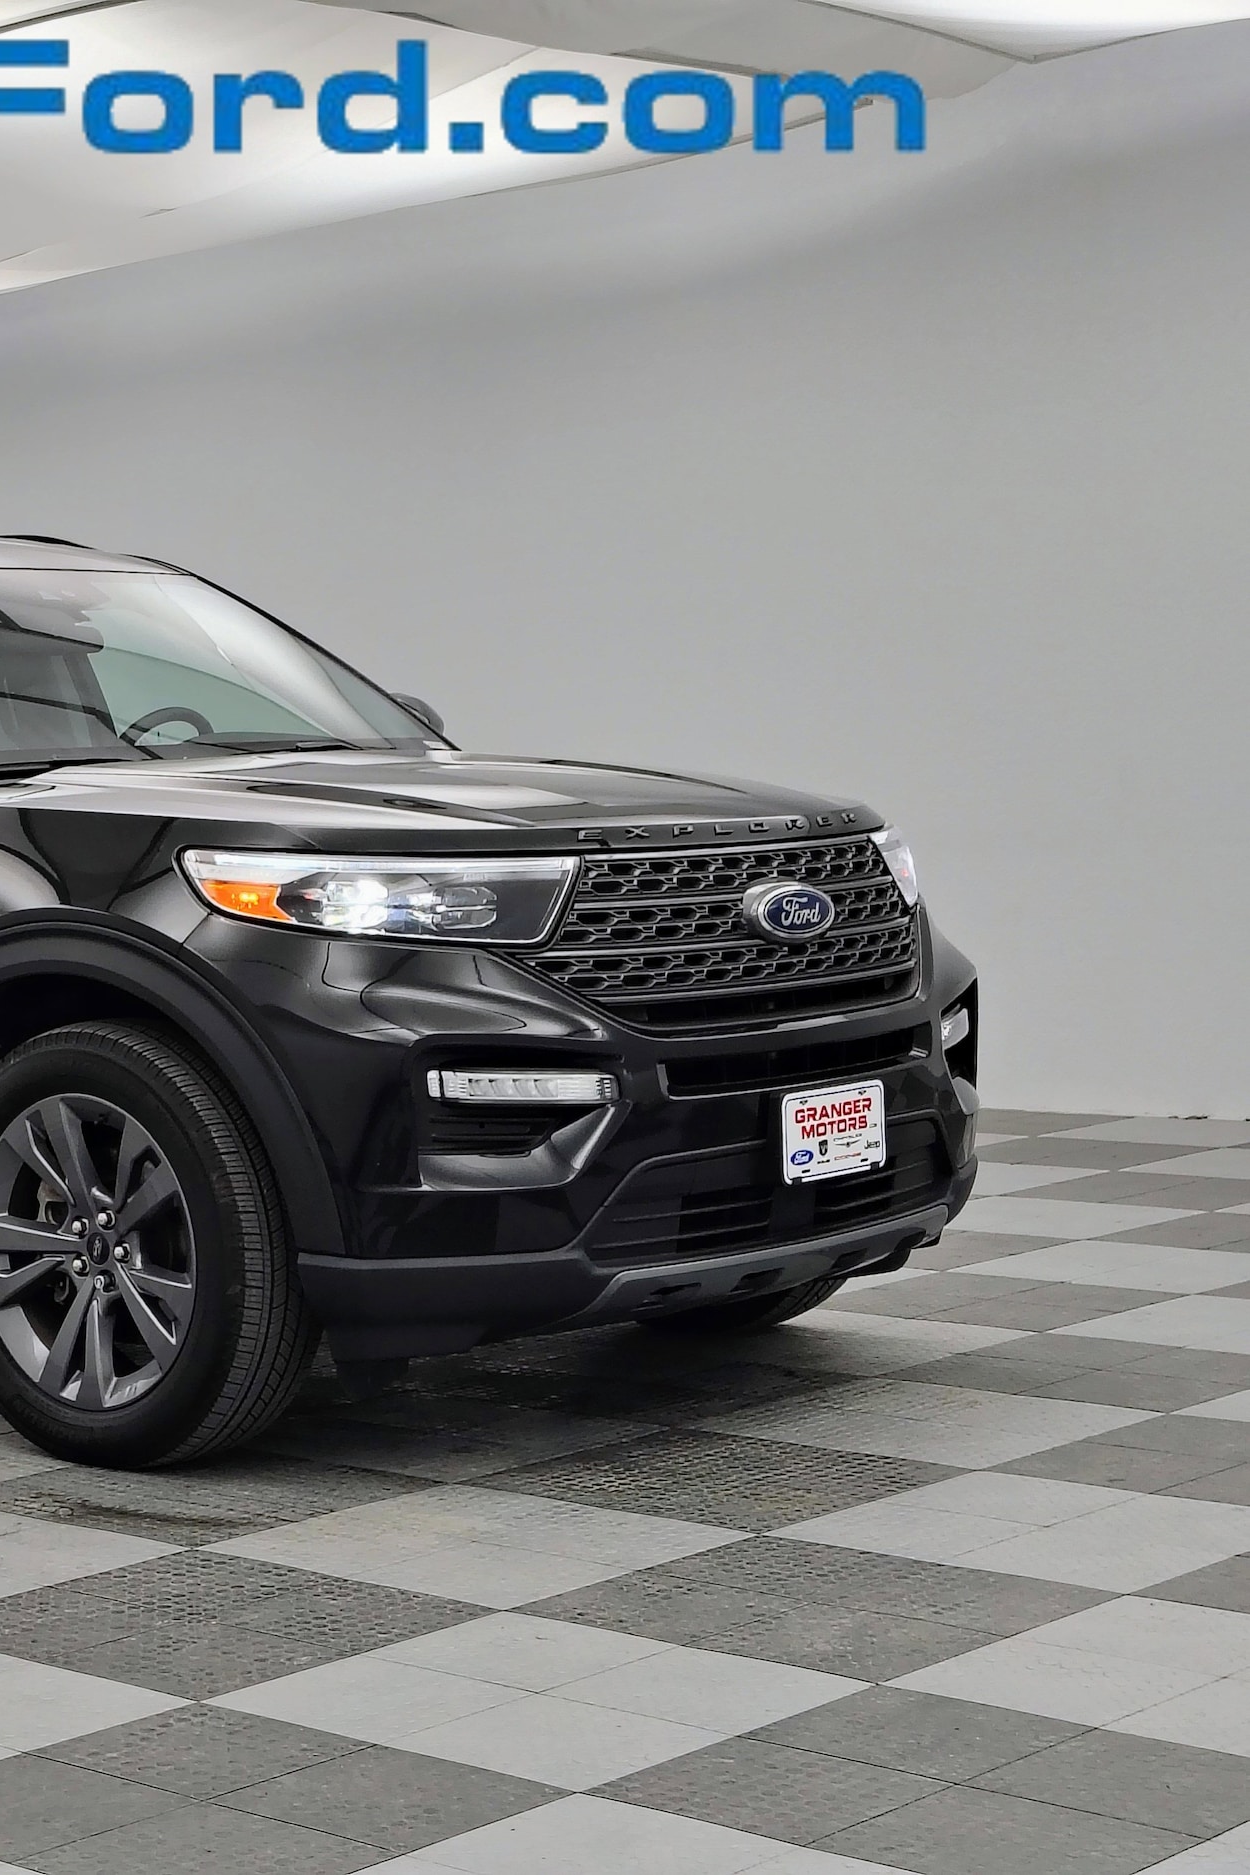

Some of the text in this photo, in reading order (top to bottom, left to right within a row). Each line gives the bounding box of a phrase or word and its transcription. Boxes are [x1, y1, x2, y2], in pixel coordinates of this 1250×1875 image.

[577, 811, 858, 842] EXPLORER
[781, 896, 821, 927] Ford
[794, 1097, 872, 1124] GRANGER
[801, 1115, 868, 1140] MOTORS
